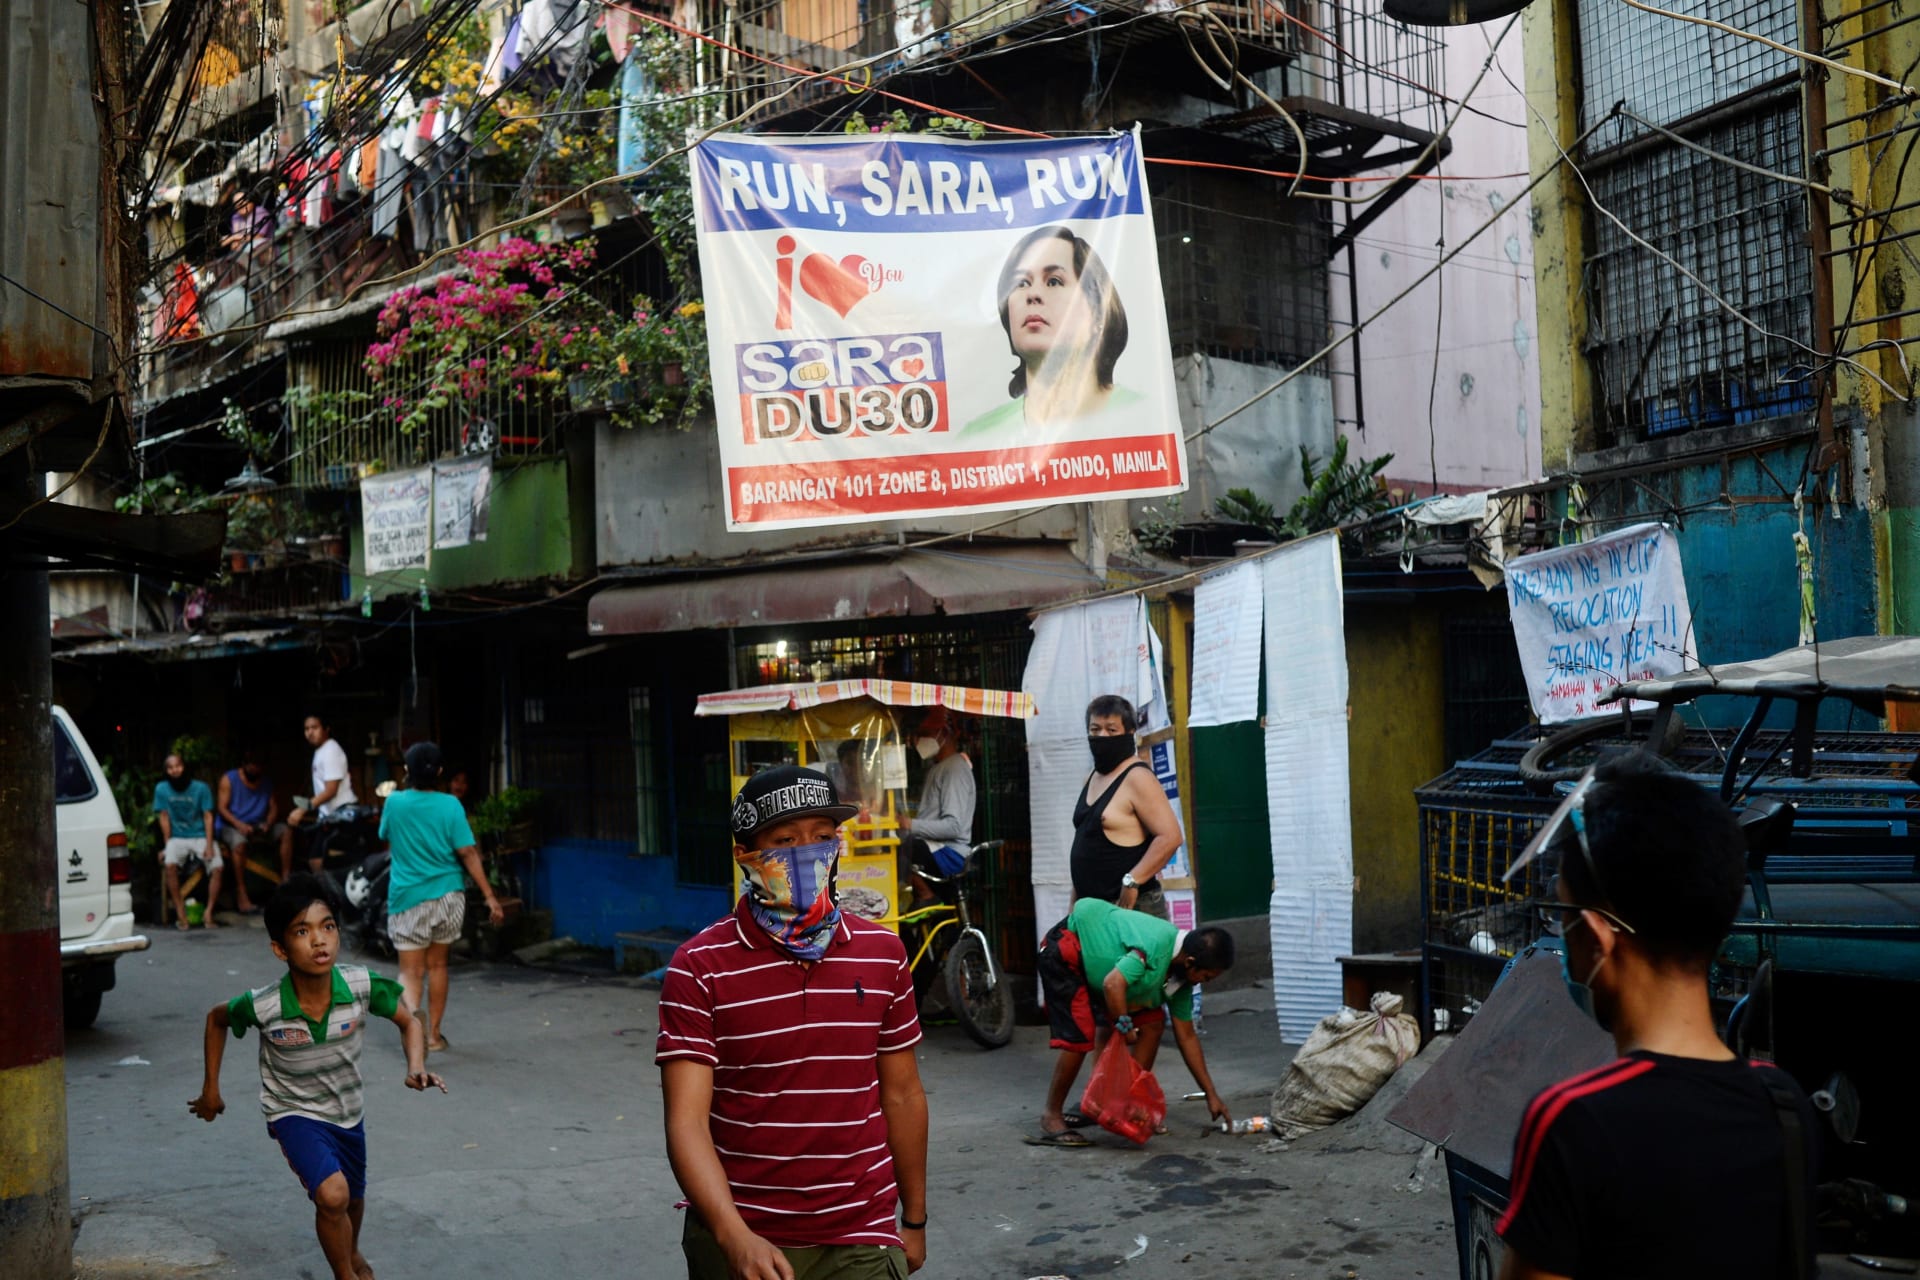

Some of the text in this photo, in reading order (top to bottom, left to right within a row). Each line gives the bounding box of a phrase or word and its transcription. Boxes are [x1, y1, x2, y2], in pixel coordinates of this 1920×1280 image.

[718, 146, 1128, 227] RUN, SARA, RUN
[861, 262, 904, 292] You
[753, 384, 937, 440] DU30
[740, 450, 1168, 504] BARANGAY 101 ZONE 8, DISTRICT 1, TONDO, MANILA
[1548, 580, 1643, 634] RELOCATION
[1546, 636, 1612, 684] STAGING
[1620, 625, 1656, 669] AREA
